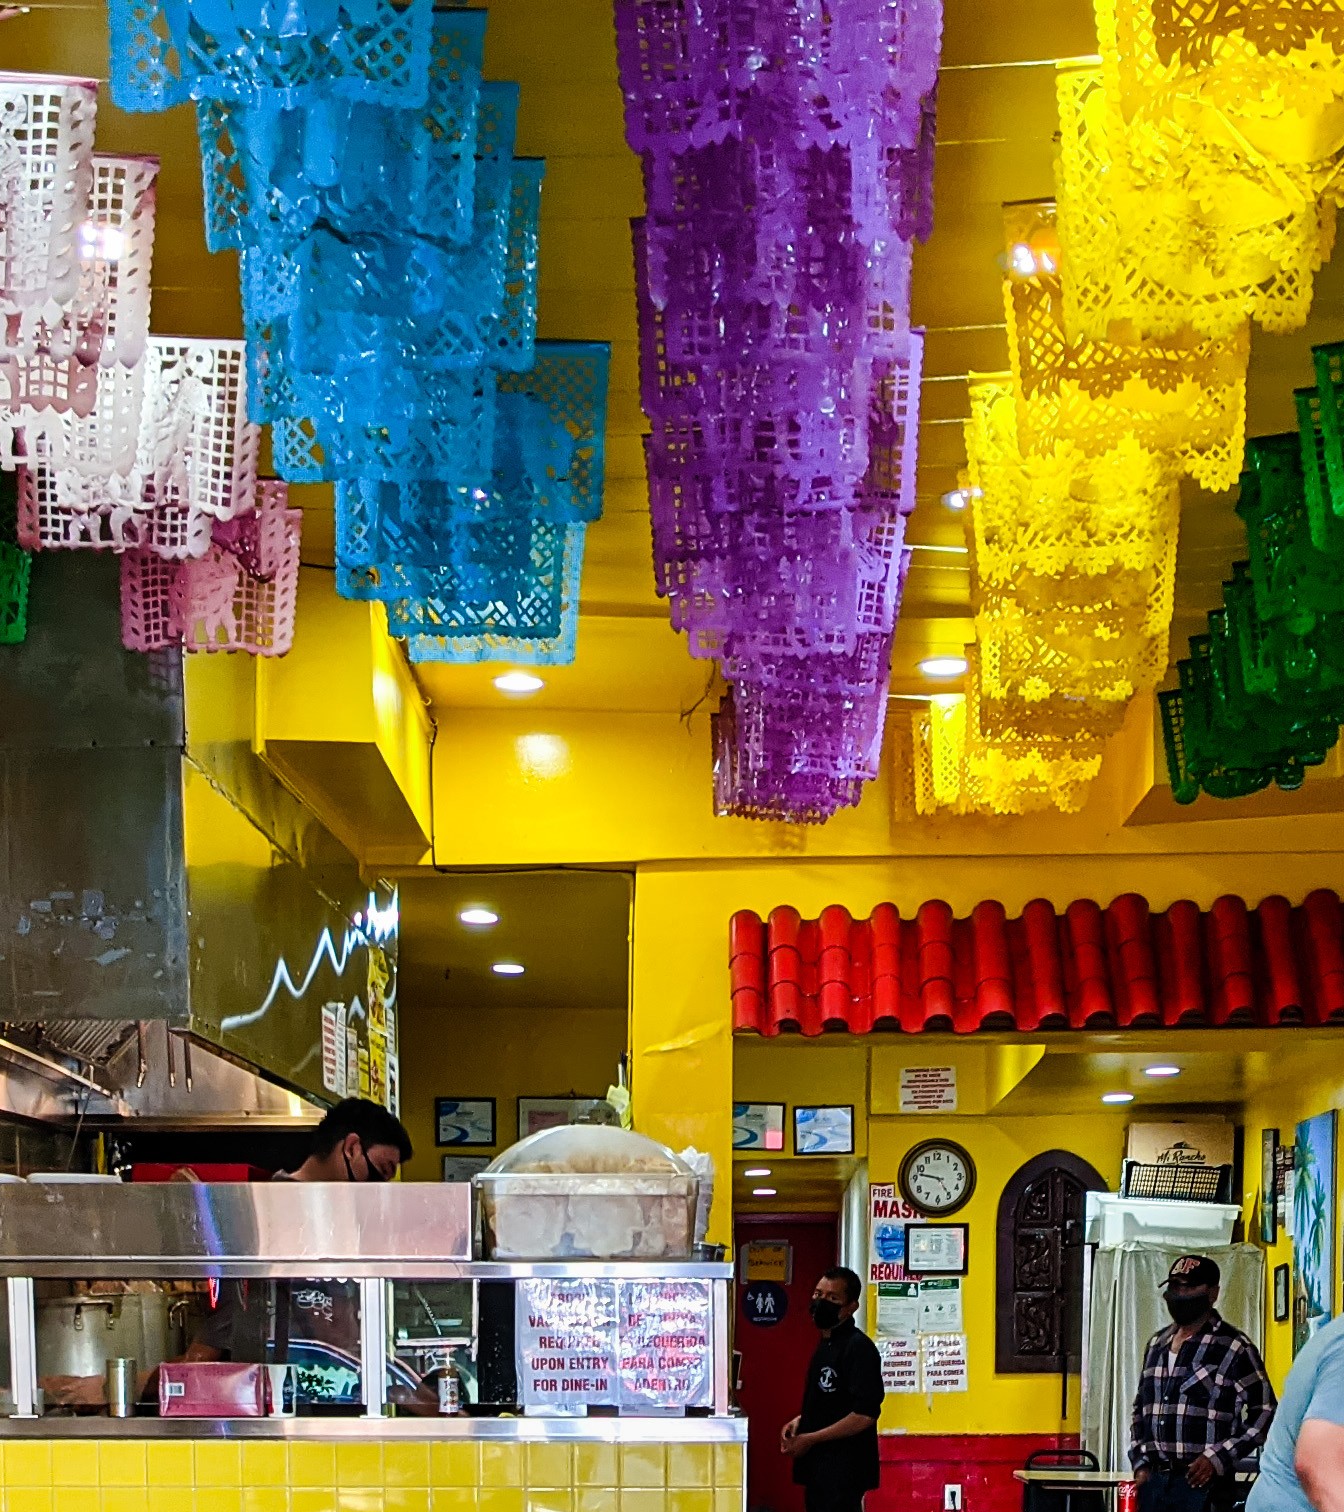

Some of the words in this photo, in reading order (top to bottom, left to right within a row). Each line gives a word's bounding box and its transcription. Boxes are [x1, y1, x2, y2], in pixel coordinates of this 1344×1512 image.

[1173, 1150, 1206, 1163] Rancho
[872, 1188, 893, 1198] FIRE
[531, 1357, 565, 1370] UPON
[569, 1357, 609, 1370] ENTRY
[622, 1357, 654, 1369] PARA
[533, 1379, 558, 1391] FOR
[561, 1378, 608, 1391] DINE-IN
